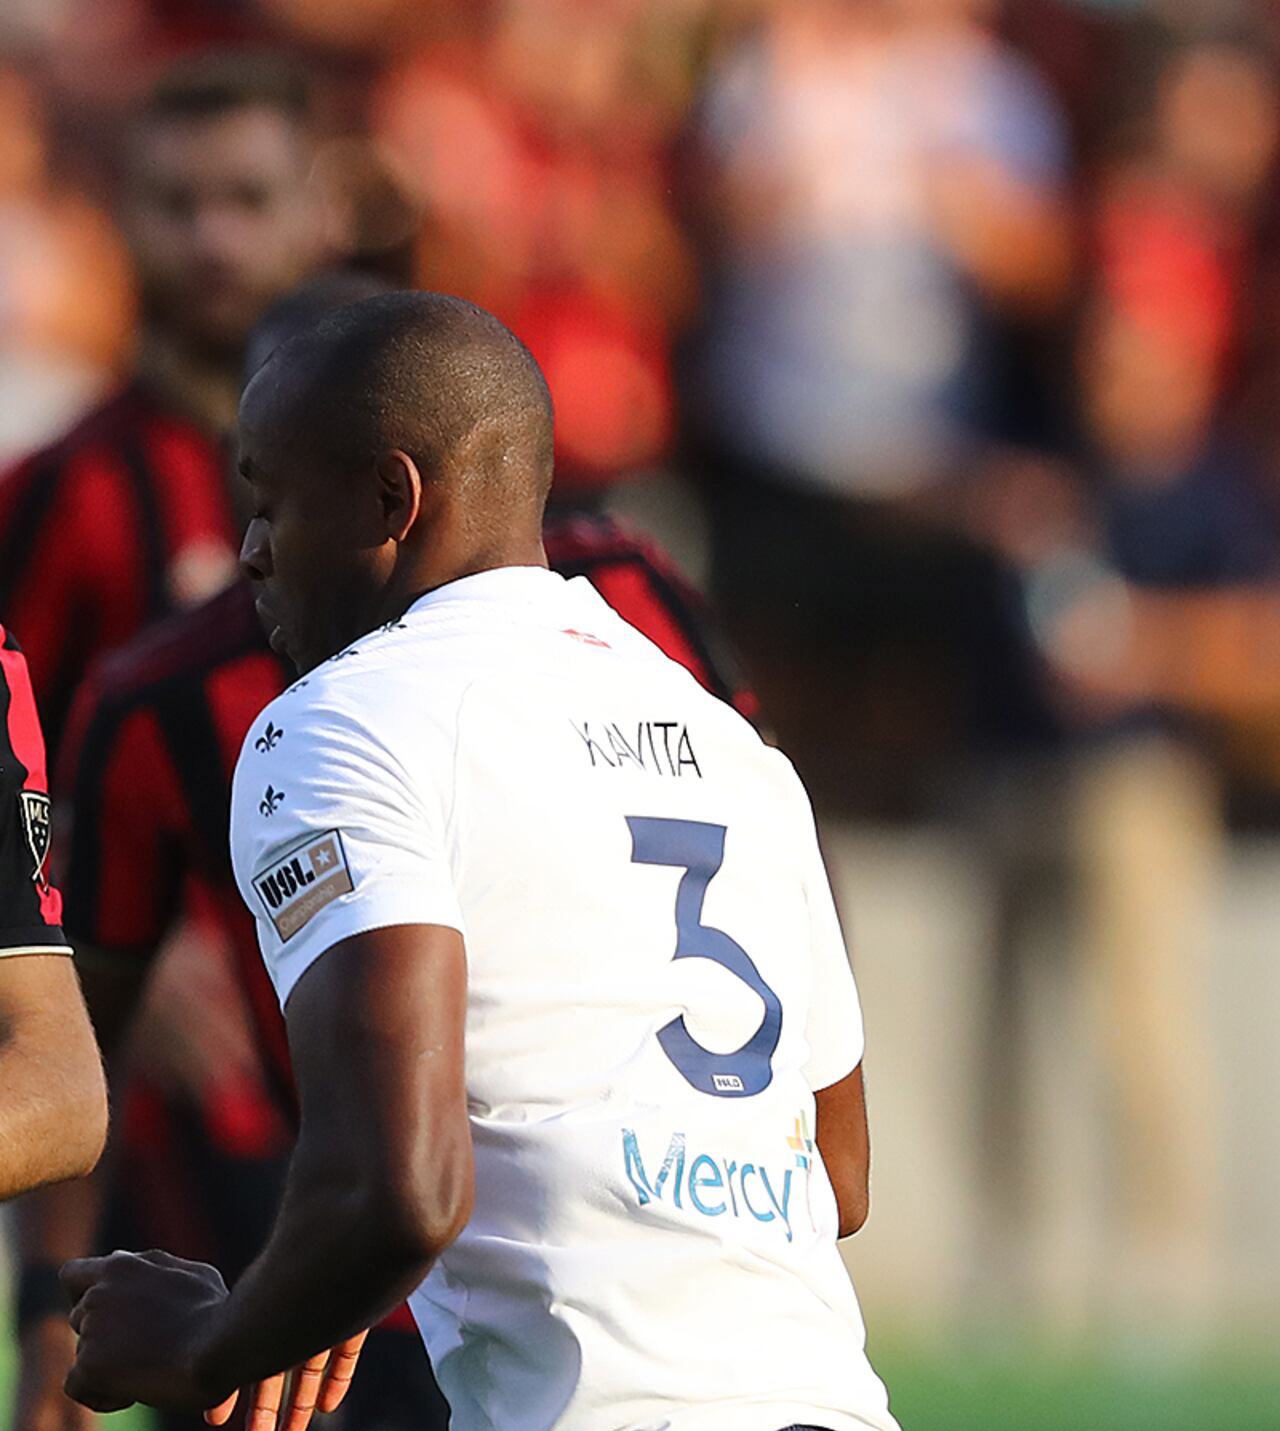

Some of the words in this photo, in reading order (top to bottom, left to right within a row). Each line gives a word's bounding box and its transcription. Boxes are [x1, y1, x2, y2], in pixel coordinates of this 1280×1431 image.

[567, 717, 703, 779] KAVITA
[259, 857, 316, 909] USL
[624, 814, 783, 1099] 3
[622, 1127, 793, 1243] Mercy
